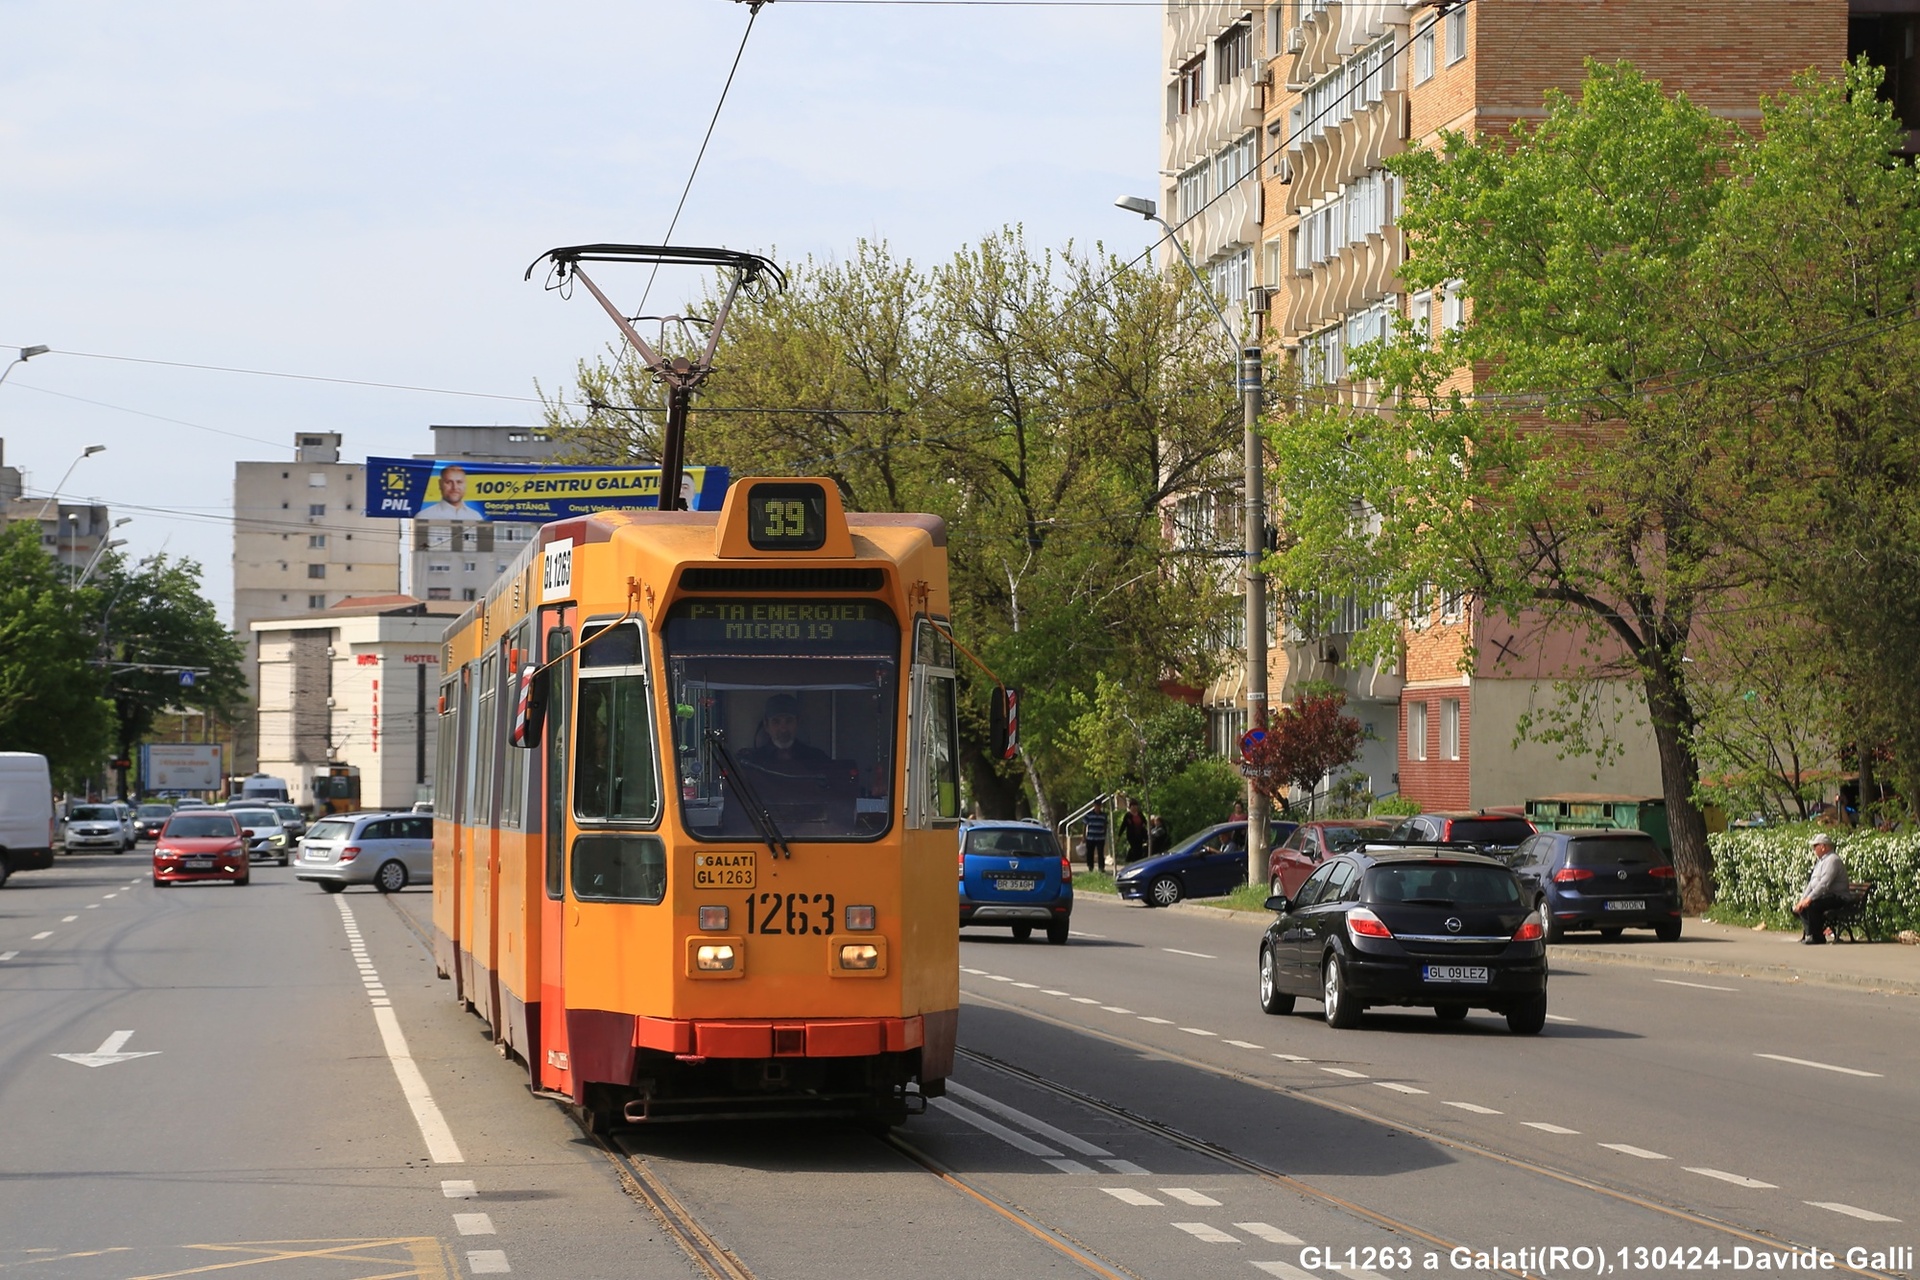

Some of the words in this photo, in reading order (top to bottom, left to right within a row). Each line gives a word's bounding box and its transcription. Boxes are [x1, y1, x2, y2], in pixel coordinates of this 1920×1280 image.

[476, 481, 519, 494] 100%
[523, 478, 592, 493] PENTRU
[381, 499, 412, 511] PNL
[484, 502, 514, 511] George
[765, 501, 804, 536] 39
[545, 555, 553, 589] GL
[553, 550, 571, 587] 1263
[691, 604, 745, 620] P-TA
[752, 604, 866, 620] ENERGIEI
[726, 623, 799, 639] MICRO
[808, 623, 833, 639] 19
[404, 654, 439, 663] HOTEL
[705, 856, 753, 866] GALATI
[697, 870, 715, 883] GL
[717, 870, 753, 884] 1263
[745, 892, 834, 935] 1263
[1430, 967, 1444, 978] GL
